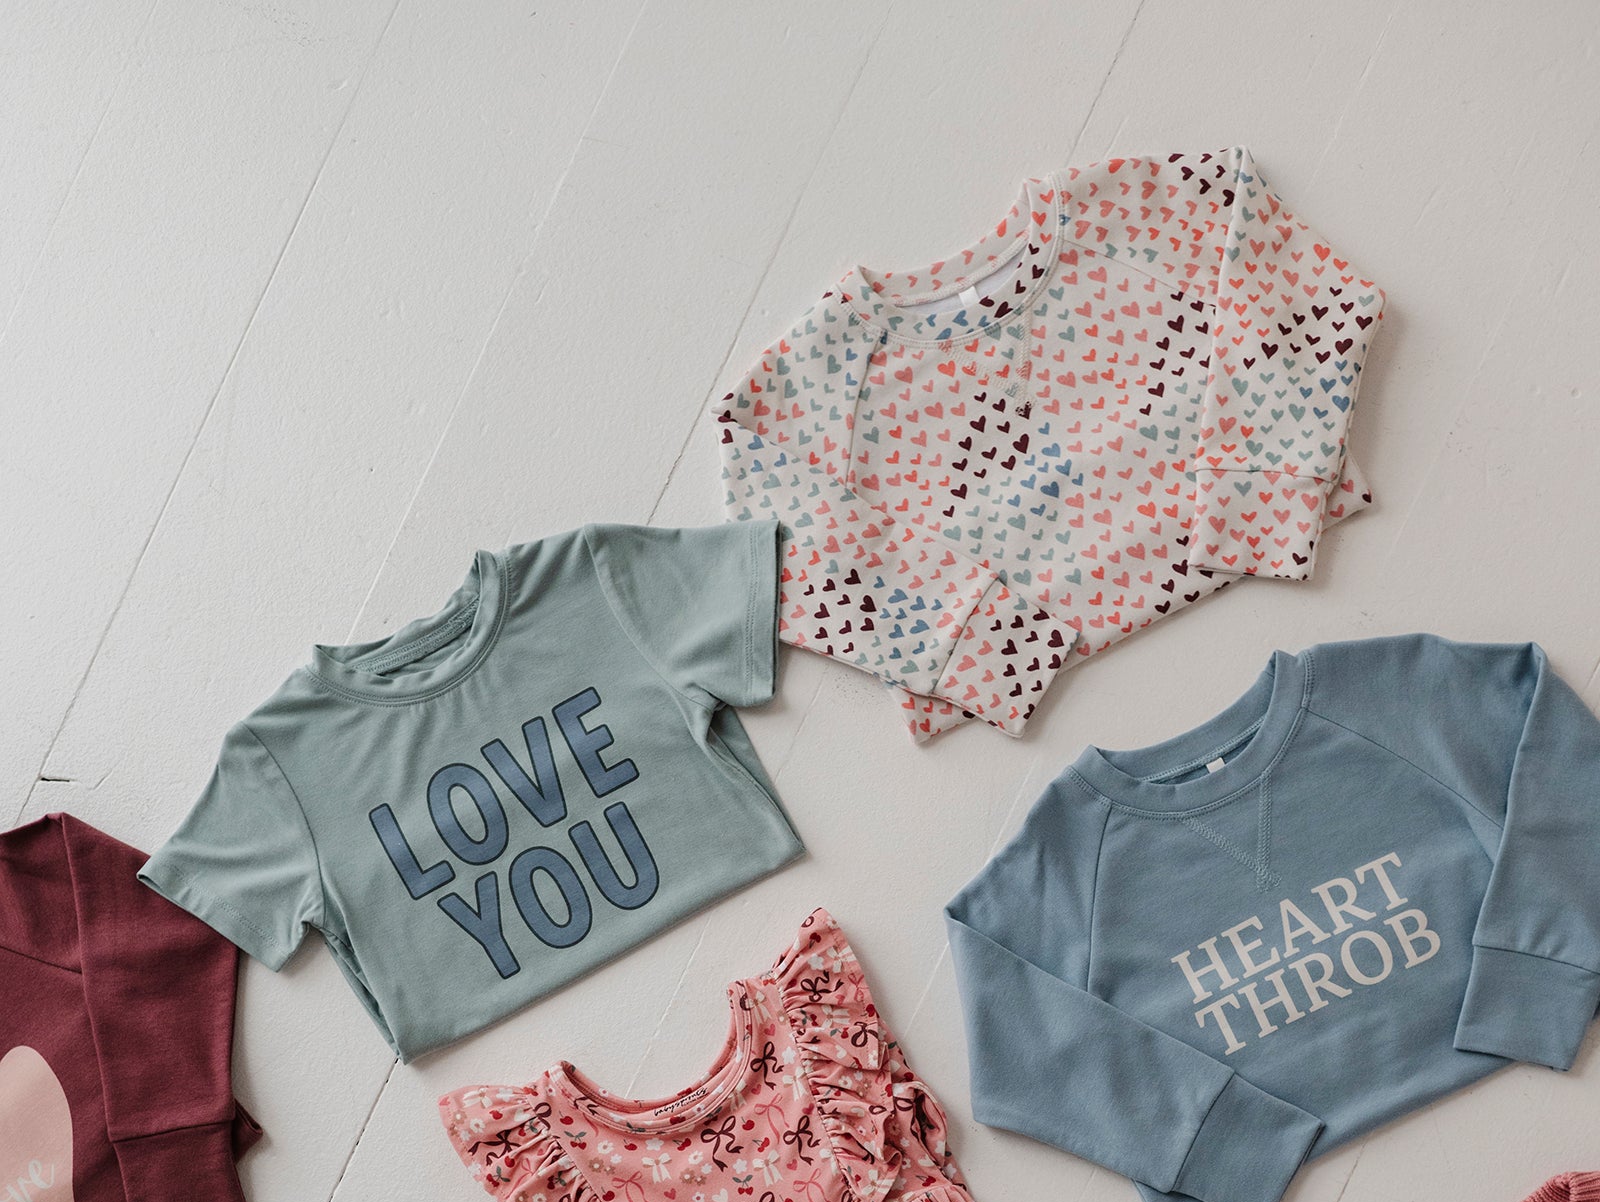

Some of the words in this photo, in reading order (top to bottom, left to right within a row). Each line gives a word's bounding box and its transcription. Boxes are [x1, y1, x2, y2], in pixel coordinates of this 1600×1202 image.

[368, 686, 640, 900] LOVE
[436, 801, 660, 980] YOU
[1170, 851, 1409, 1005] HEART
[1194, 908, 1441, 1056] THROB
